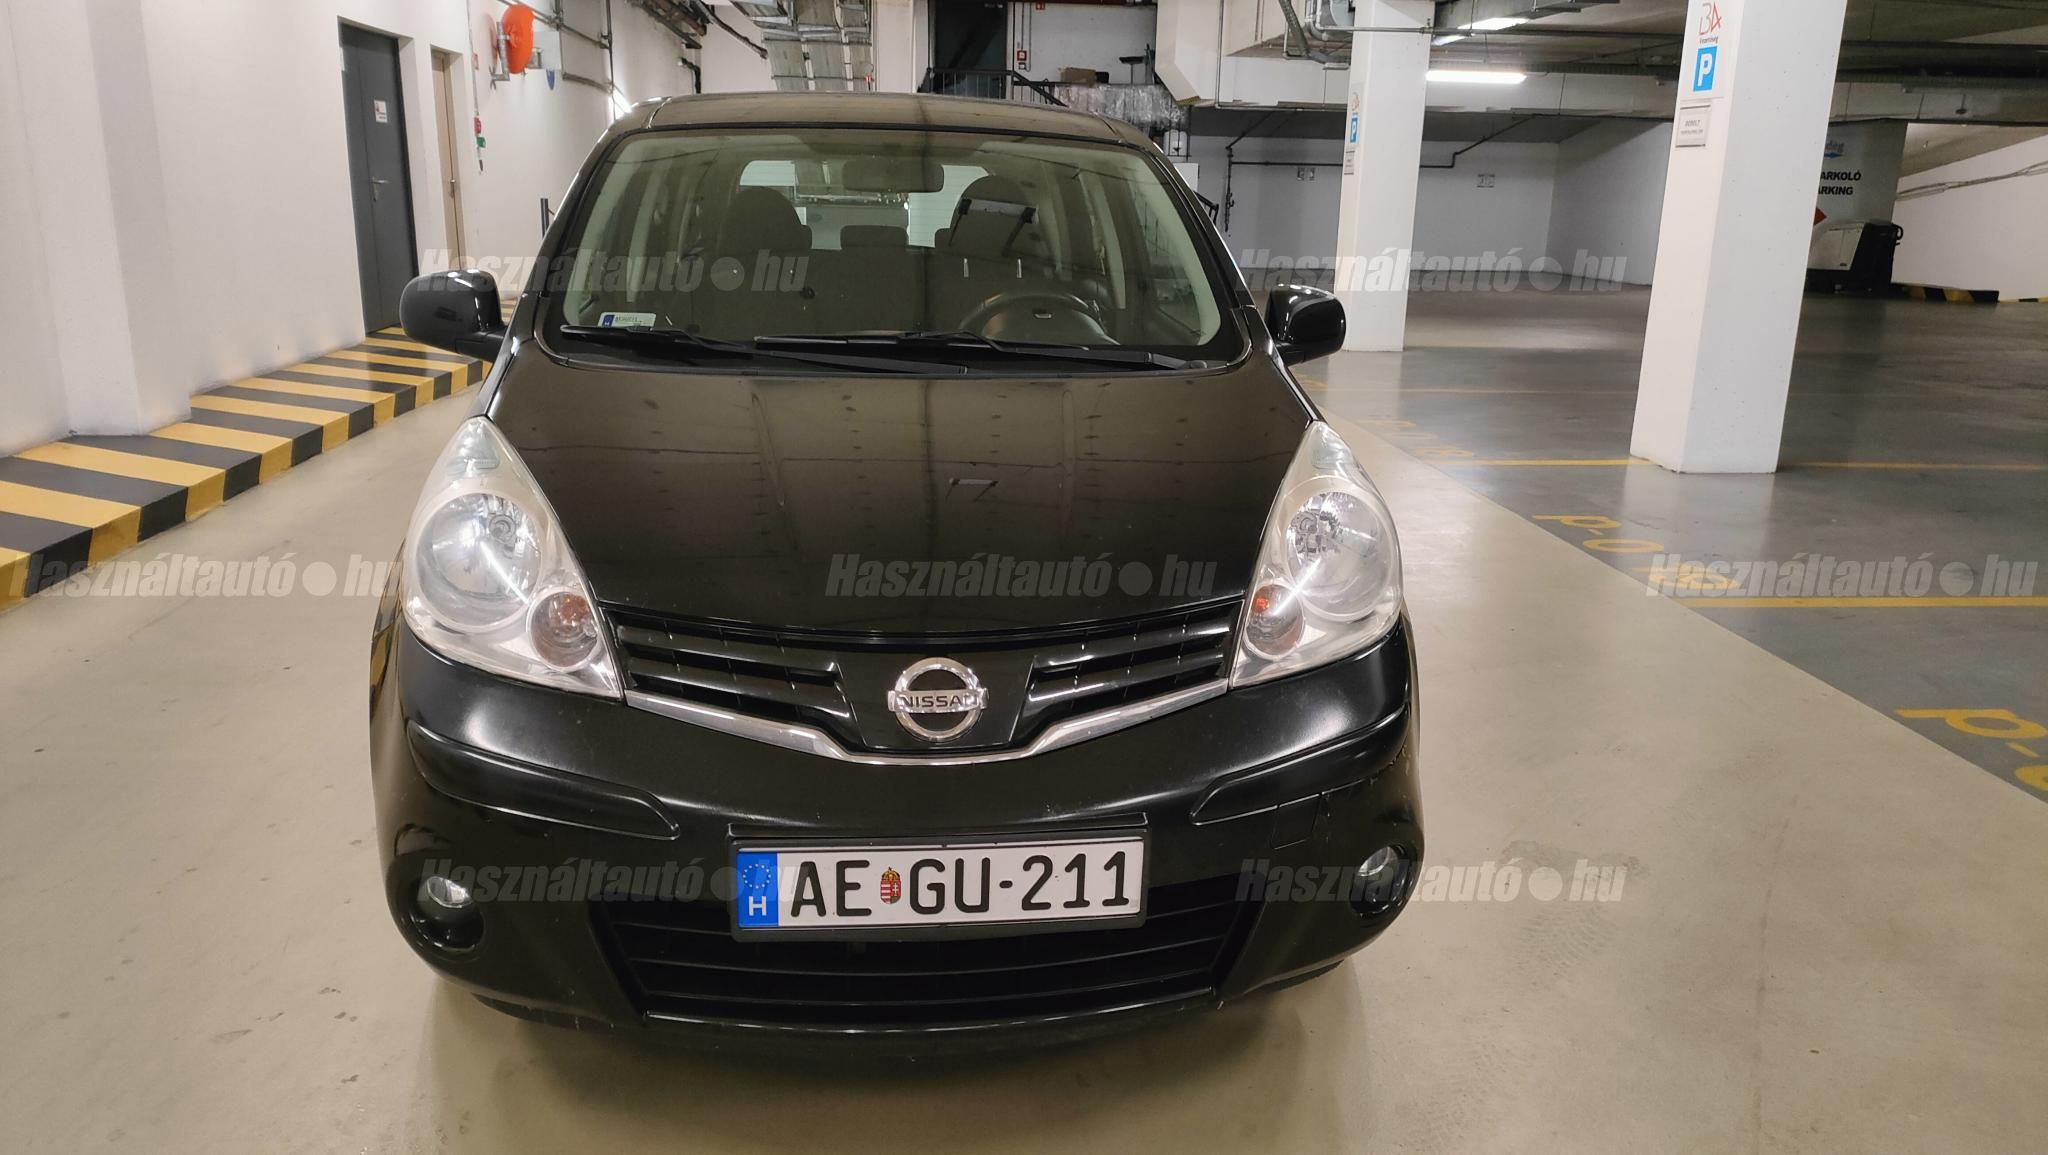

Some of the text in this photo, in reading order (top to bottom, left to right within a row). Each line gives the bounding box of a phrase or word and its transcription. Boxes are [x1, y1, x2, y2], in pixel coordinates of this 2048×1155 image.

[1698, 53, 1713, 87] P
[1820, 169, 1862, 181] ARKOLÓ
[1818, 186, 1854, 195] RKING
[899, 694, 979, 708] NISSAN
[748, 896, 767, 917] H
